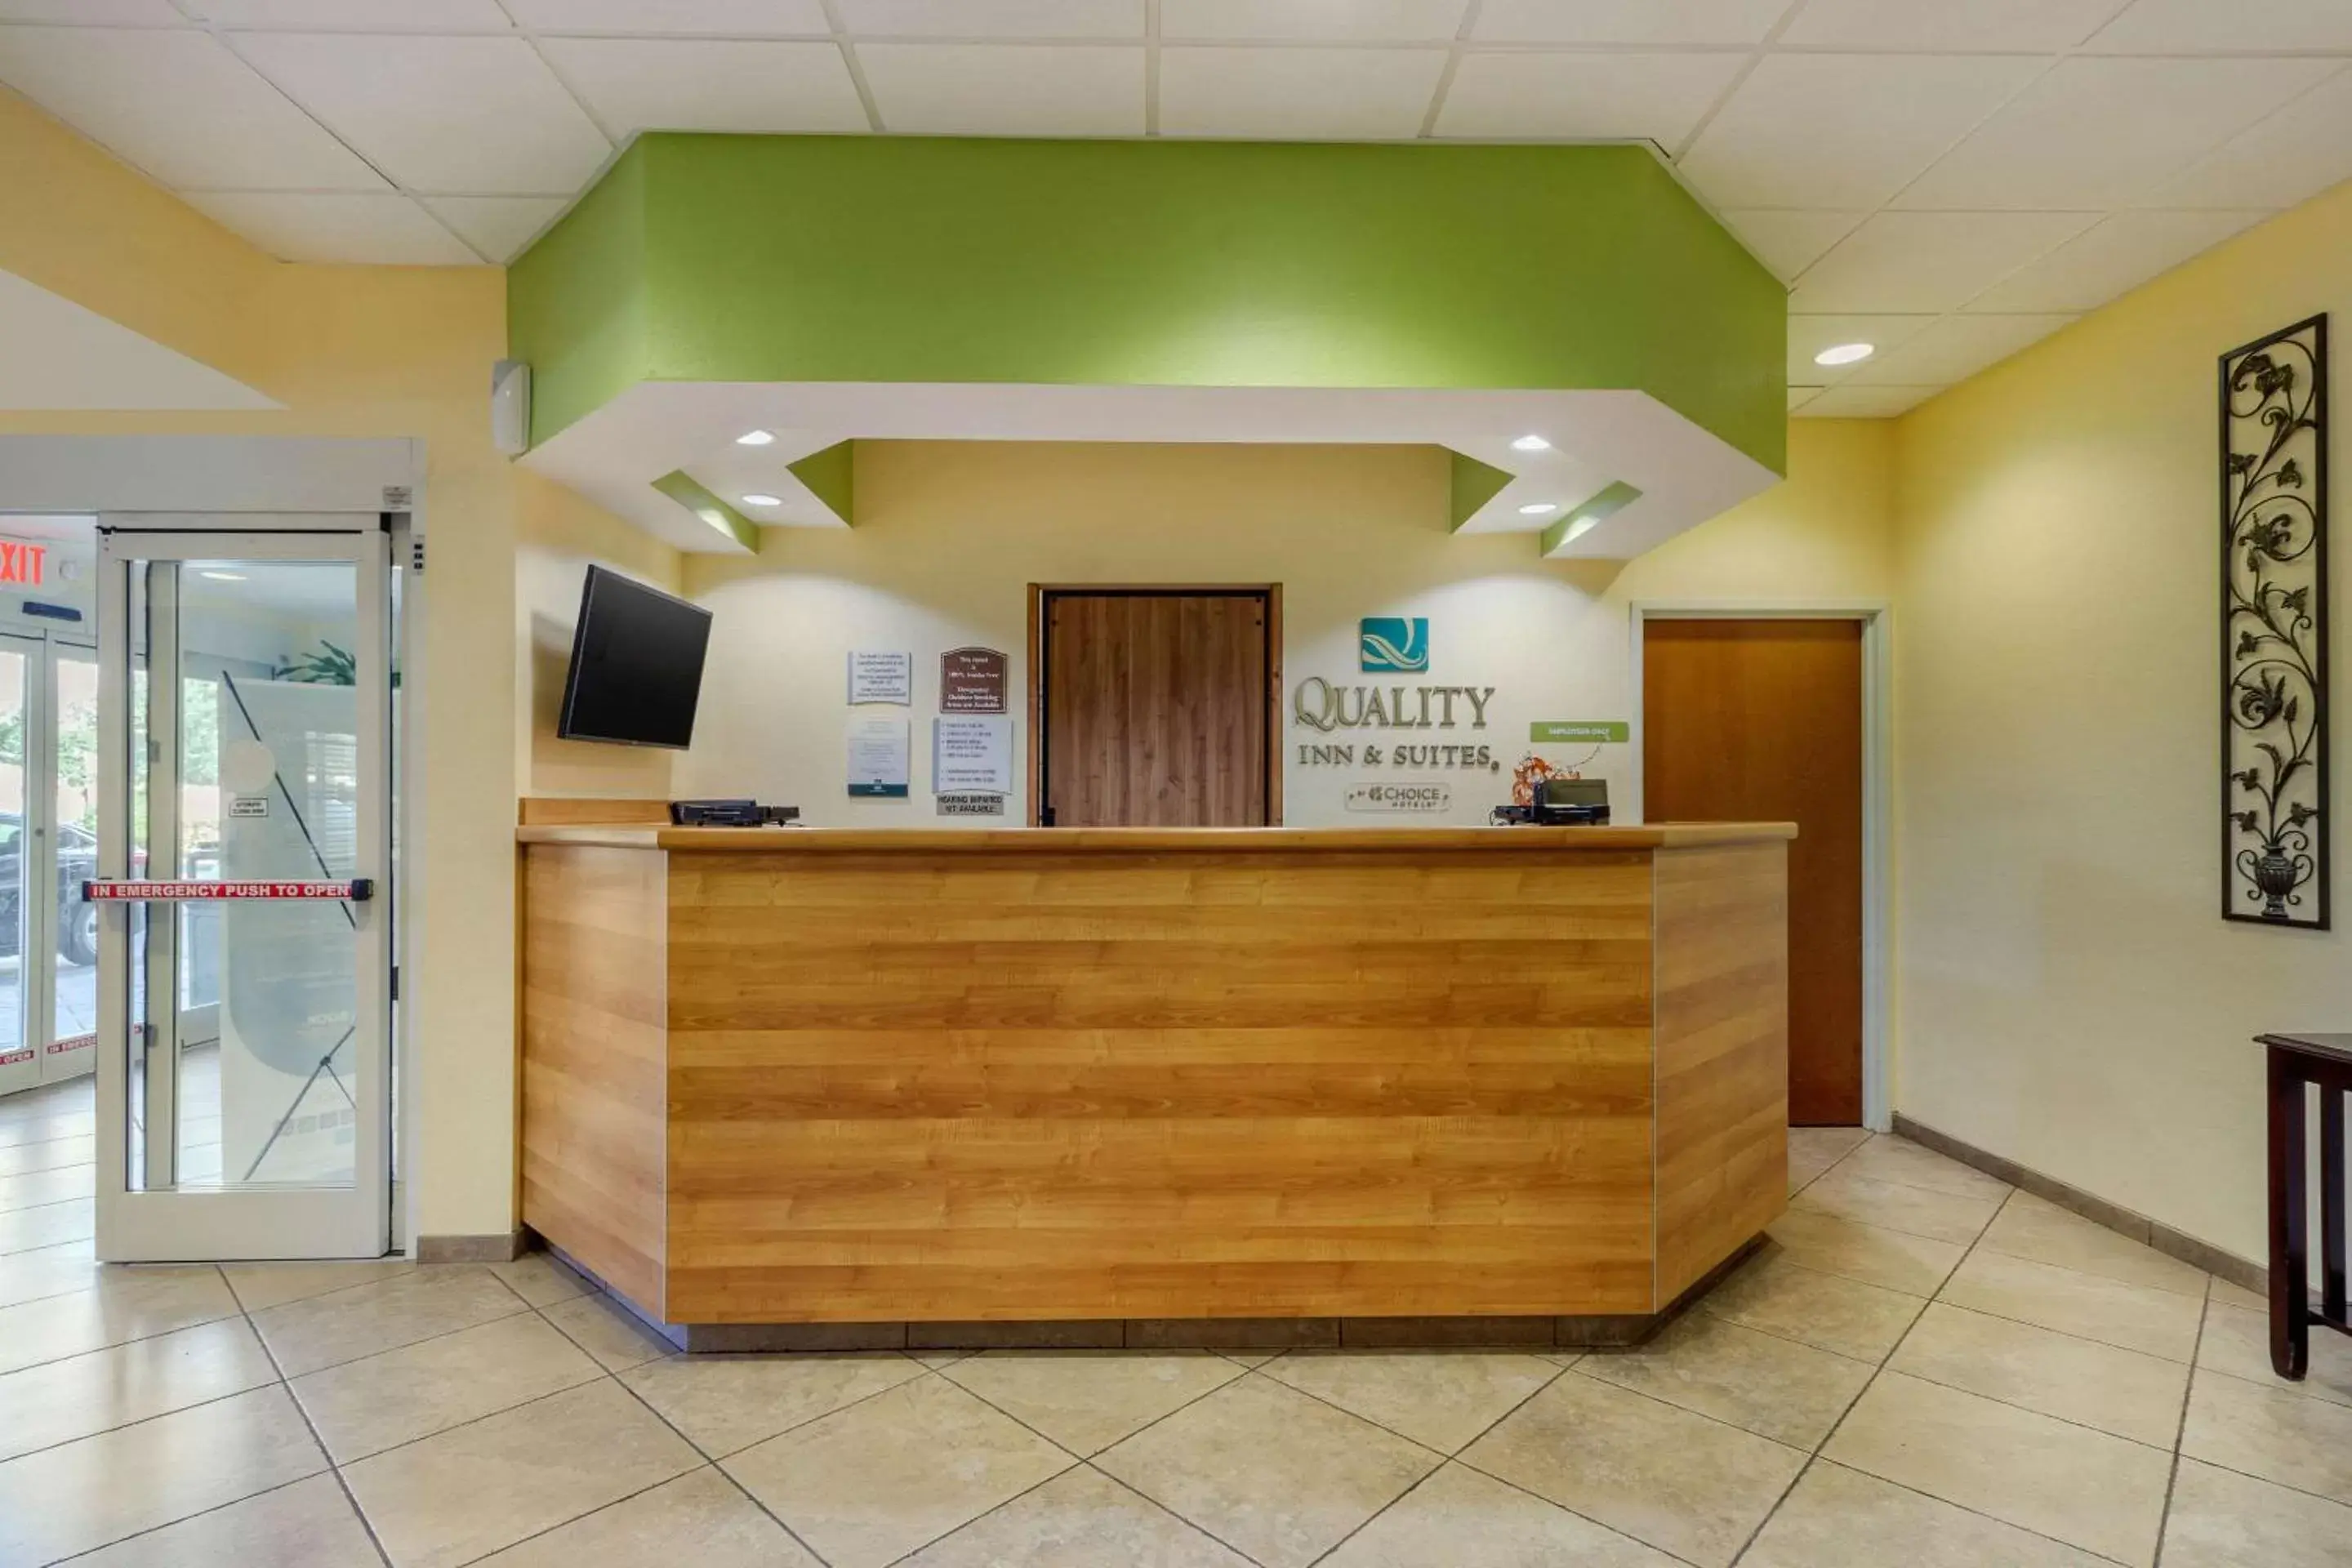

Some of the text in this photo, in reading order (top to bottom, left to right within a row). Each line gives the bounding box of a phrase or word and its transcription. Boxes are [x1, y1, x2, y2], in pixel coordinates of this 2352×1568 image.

[0, 542, 46, 585] XIT
[1294, 676, 1495, 732] QUALITY
[1298, 744, 1354, 765] INN
[1364, 744, 1383, 766] &
[1384, 786, 1440, 800] CHOICE
[92, 884, 350, 897] IN EMERGENCY PUSH TO OPEN
